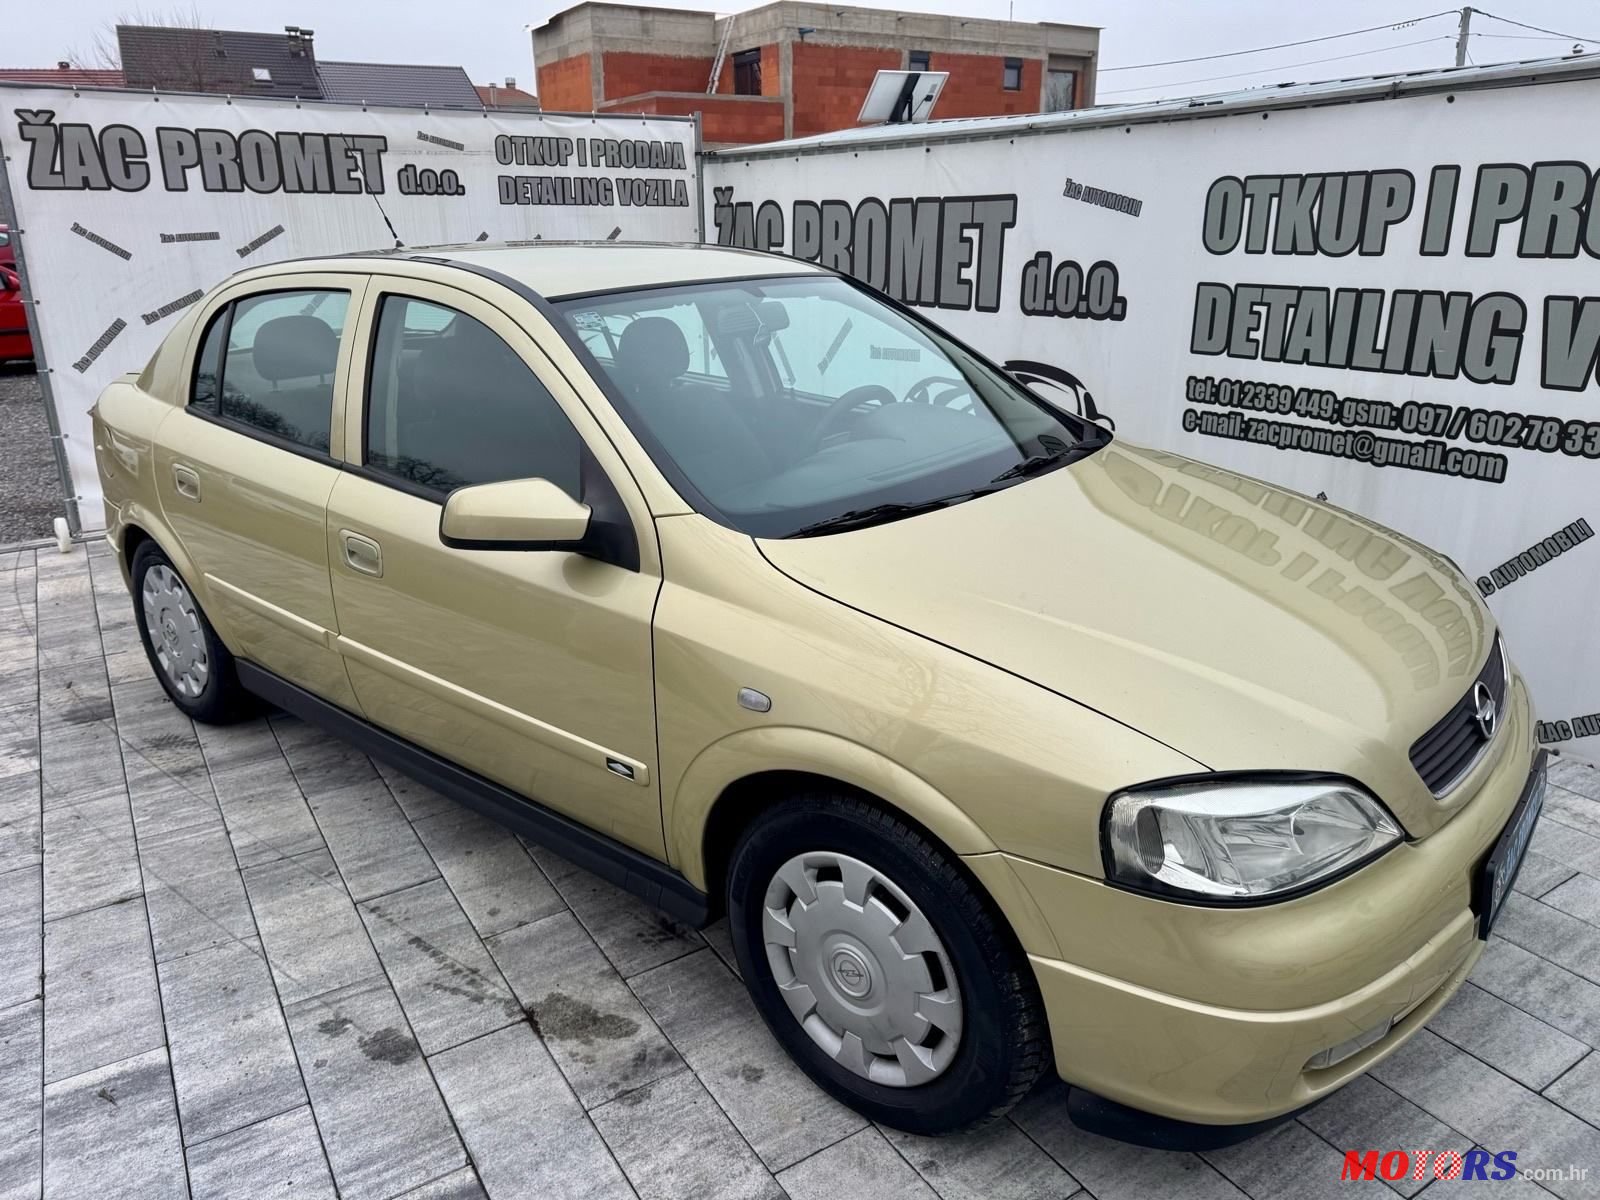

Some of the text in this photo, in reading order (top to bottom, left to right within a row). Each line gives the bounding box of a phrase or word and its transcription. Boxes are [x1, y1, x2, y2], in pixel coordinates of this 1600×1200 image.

[14, 109, 466, 196] ŽAC PROMET d.o.o.
[495, 134, 687, 170] OTKUP I PRODAJA
[498, 175, 689, 207] DETAILING VOZILA
[1081, 185, 1143, 217] AUTOMOBILI
[1202, 168, 1416, 257] OTKUP
[1420, 164, 1461, 257] I
[792, 193, 1018, 313] PROMET
[1020, 251, 1127, 321] d.o.o.
[1190, 282, 1527, 385] DETAILING
[1186, 376, 1217, 404] tel:
[1340, 397, 1400, 430] gsm:
[1182, 408, 1508, 484] e-mail: zacpromet@gmail.com
[1490, 517, 1595, 590] AUTOMOBILI
